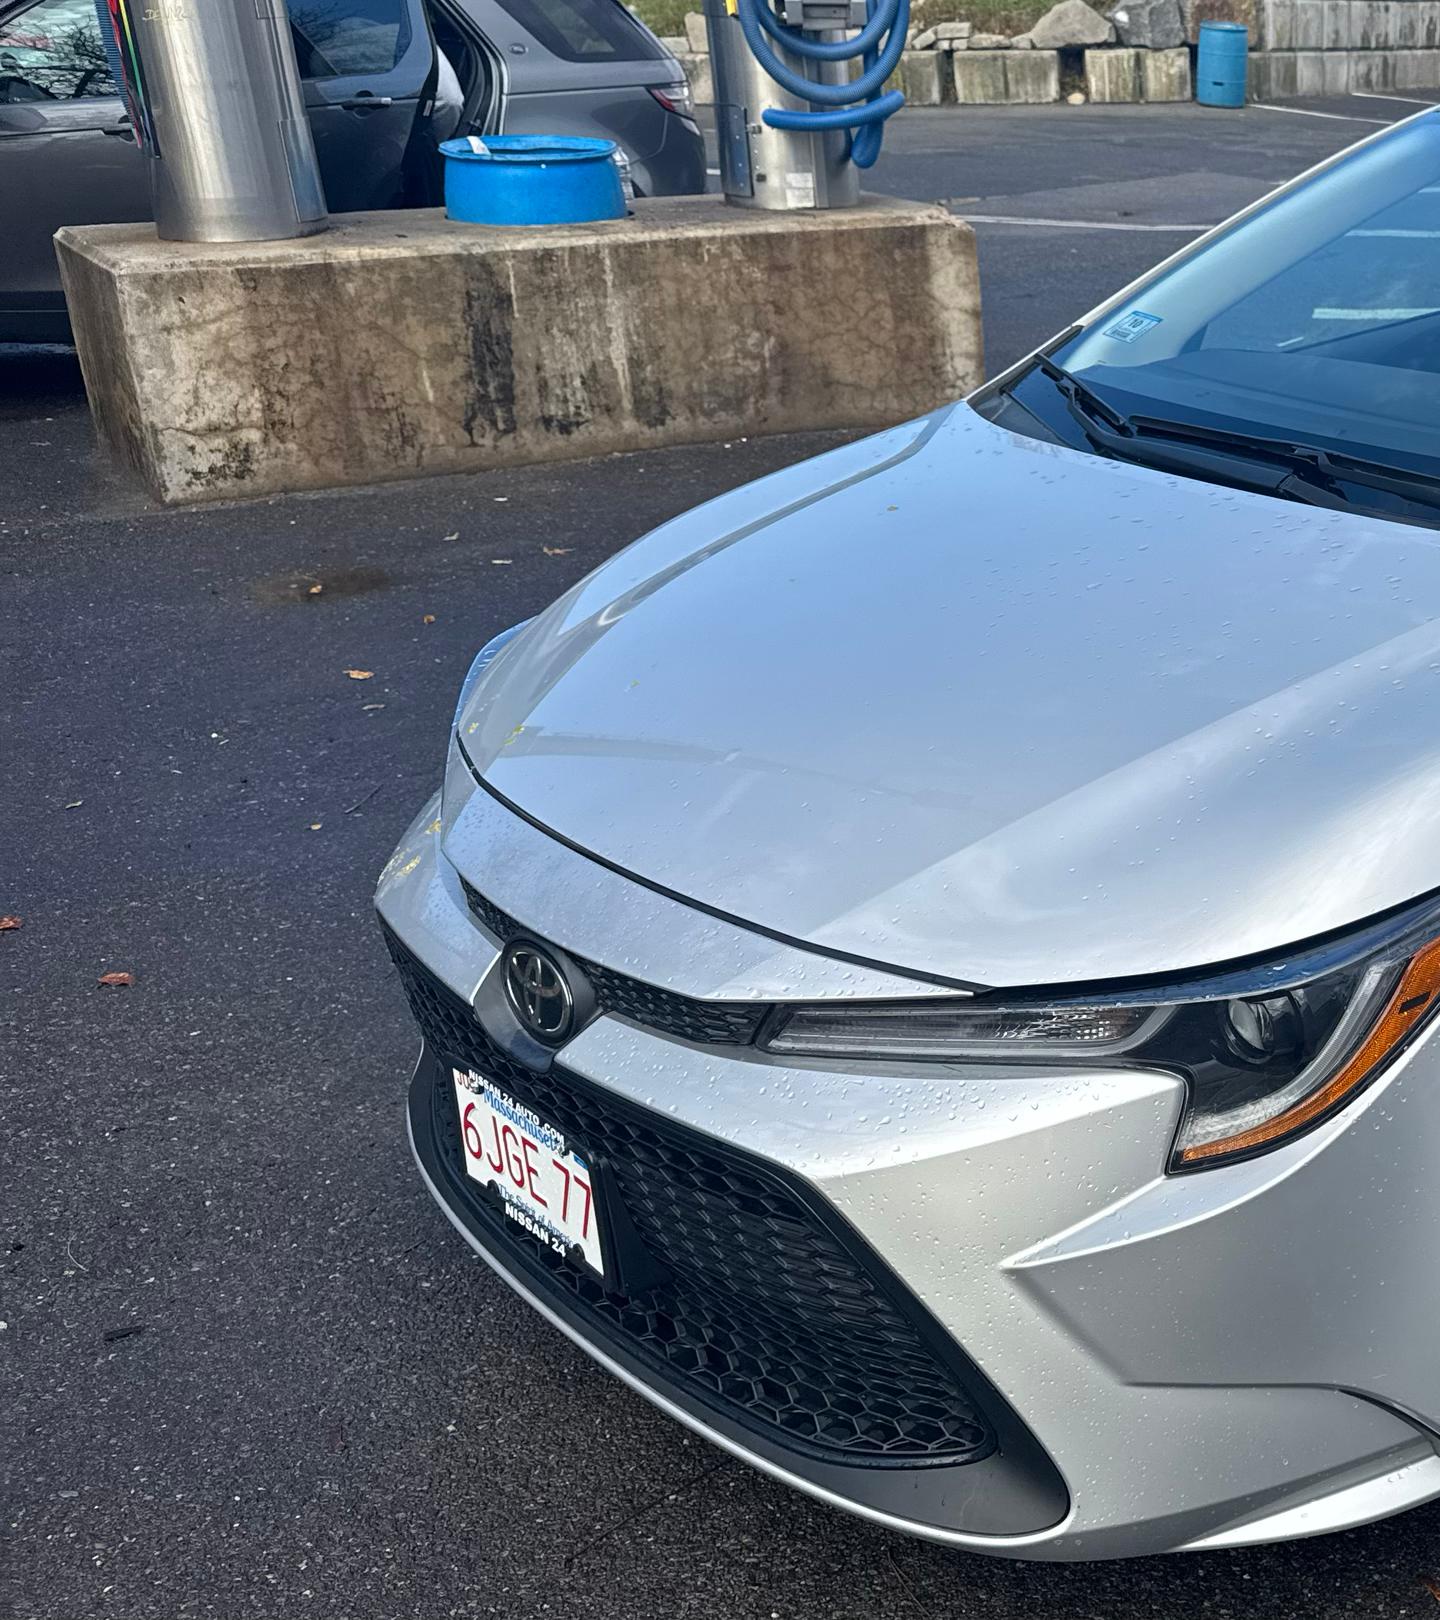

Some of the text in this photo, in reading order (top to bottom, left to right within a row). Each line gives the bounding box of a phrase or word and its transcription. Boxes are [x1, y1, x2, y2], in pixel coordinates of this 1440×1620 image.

[468, 1069, 501, 1098] NISSAN
[502, 1093, 514, 1107] 24
[515, 1103, 540, 1126] AUTO
[464, 1102, 591, 1240] 6 JGE 77
[505, 1202, 566, 1257] NISSAN 24
